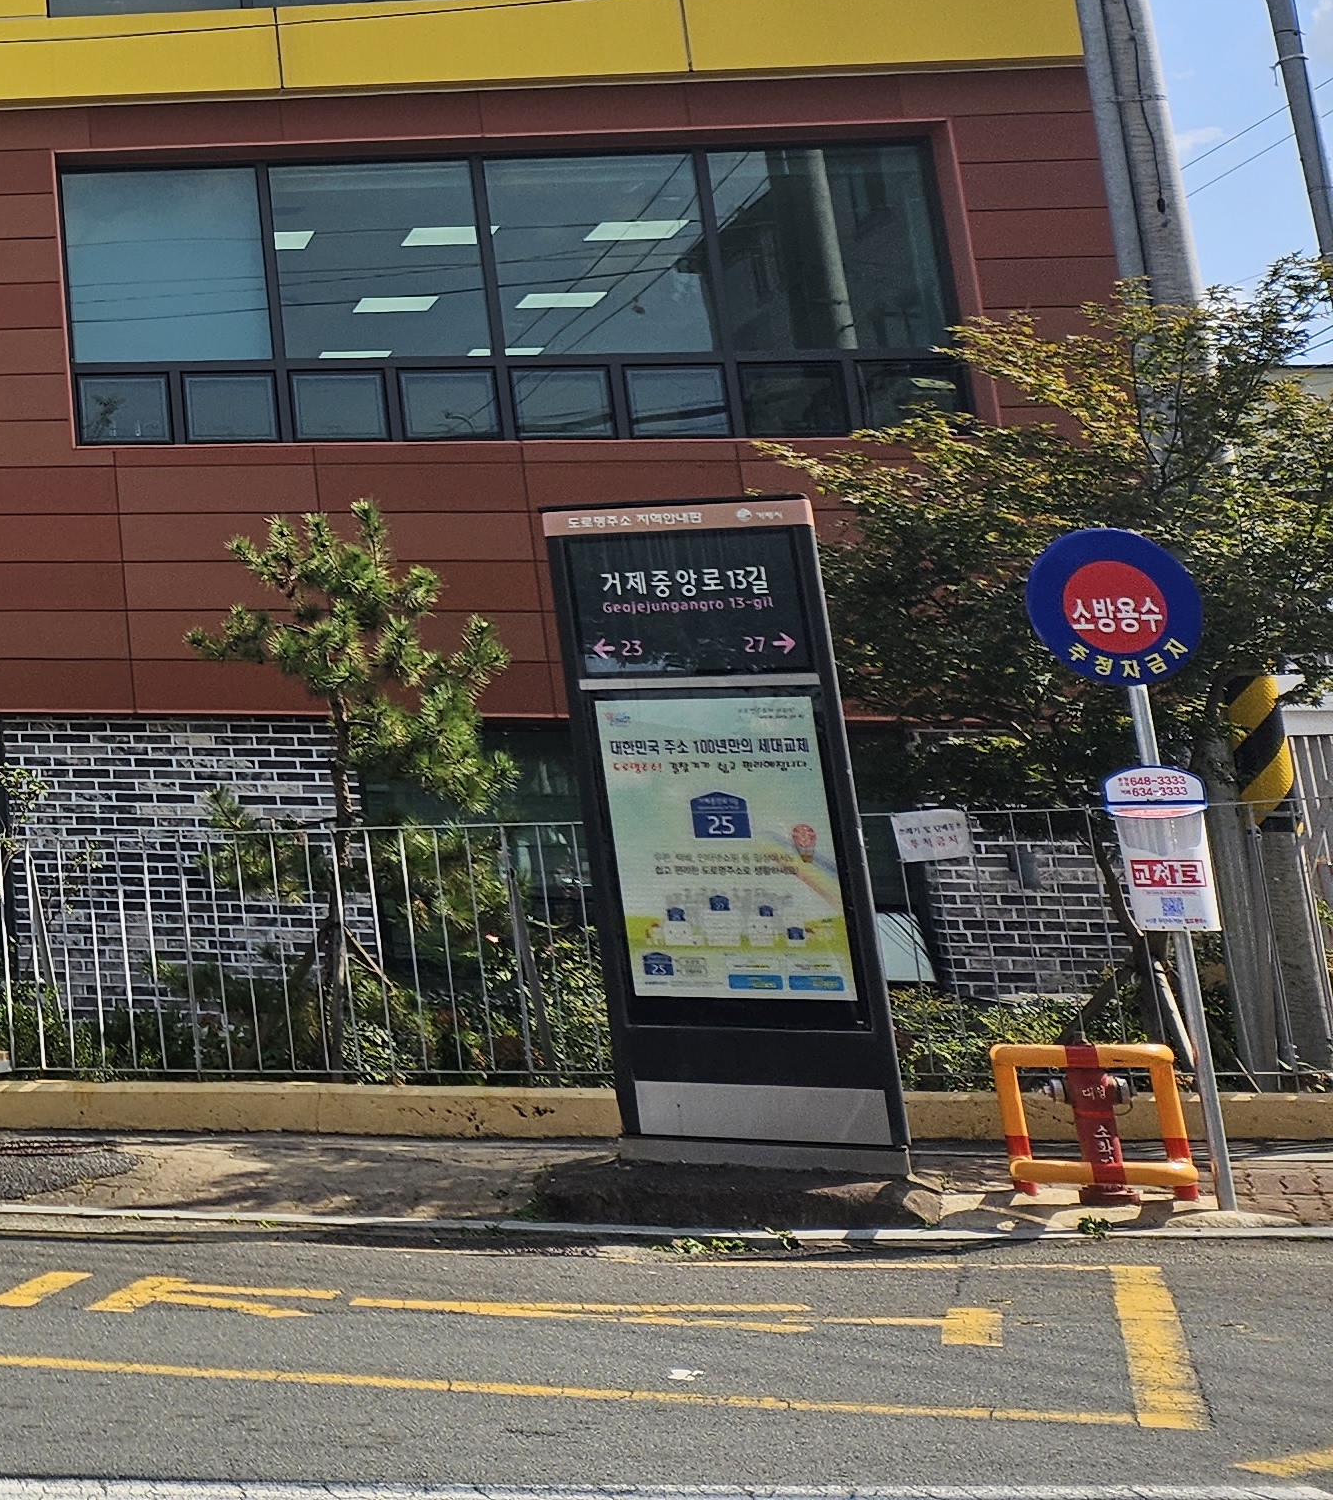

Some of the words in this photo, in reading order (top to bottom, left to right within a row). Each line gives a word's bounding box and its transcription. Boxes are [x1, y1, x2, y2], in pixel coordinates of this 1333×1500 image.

[567, 514, 632, 529] 도로명주소
[636, 511, 703, 526] 지역안내판
[602, 600, 724, 614] Geojejungangro
[729, 596, 775, 611] 13-gil
[1071, 596, 1163, 633] 소방용수
[621, 640, 643, 656] 23
[743, 636, 765, 653] 27
[609, 740, 660, 756] 대한민국
[664, 739, 690, 755] 주소
[694, 738, 753, 754] 100년만의
[758, 737, 810, 754] 세대교체
[1130, 775, 1186, 786] 648-3333
[1132, 786, 1188, 797] 634-3333
[706, 815, 735, 835] 25
[1133, 862, 1203, 885] 교차로
[651, 964, 667, 975] 25
